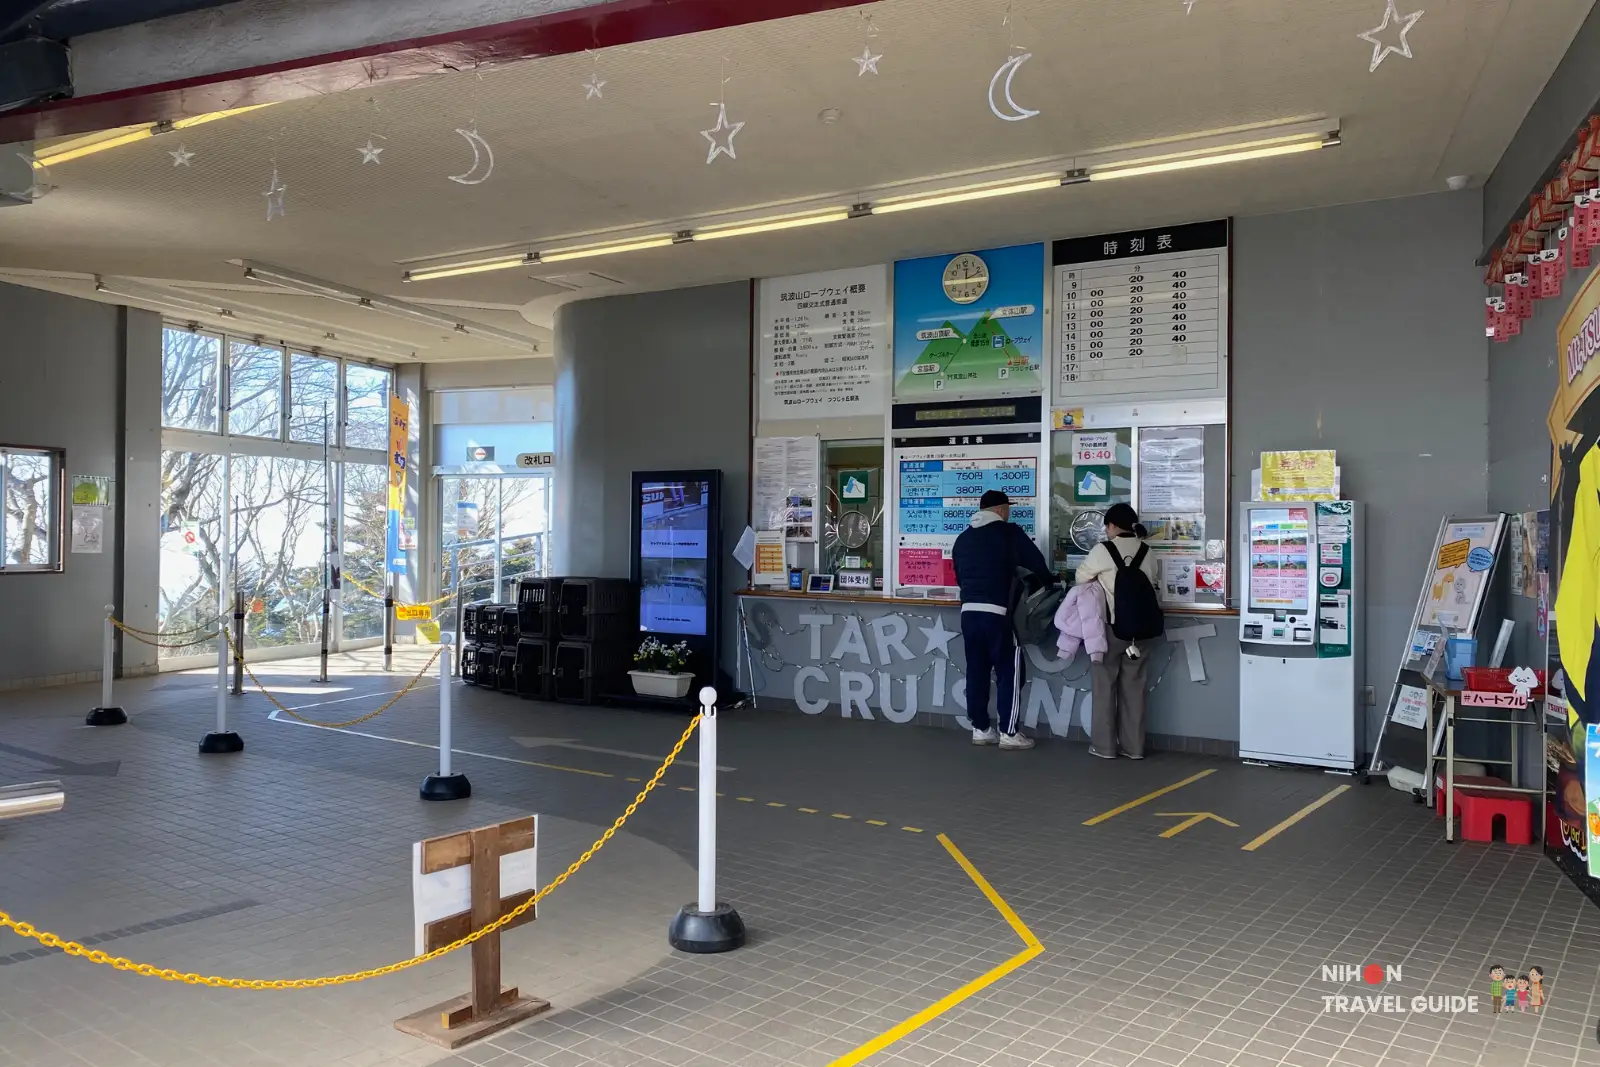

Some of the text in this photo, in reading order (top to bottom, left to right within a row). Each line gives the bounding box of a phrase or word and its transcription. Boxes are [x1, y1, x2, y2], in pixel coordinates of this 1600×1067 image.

[1104, 234, 1172, 254] 時刻表
[780, 284, 866, 301] 筑波山ロープウェイ概要
[920, 330, 951, 339] 筑波山頂駅
[1001, 369, 1006, 377] P
[936, 380, 941, 388] P
[1077, 450, 1111, 460] 16:40
[524, 455, 550, 465] 改札口
[956, 472, 982, 480] 750円
[994, 471, 1030, 480] 1,300円
[956, 486, 982, 494] 380円
[1002, 485, 1030, 493] 650円
[944, 510, 964, 518] 680円
[1011, 510, 1033, 519] 980円
[944, 523, 964, 531] 340円
[840, 574, 869, 585] 団体受付
